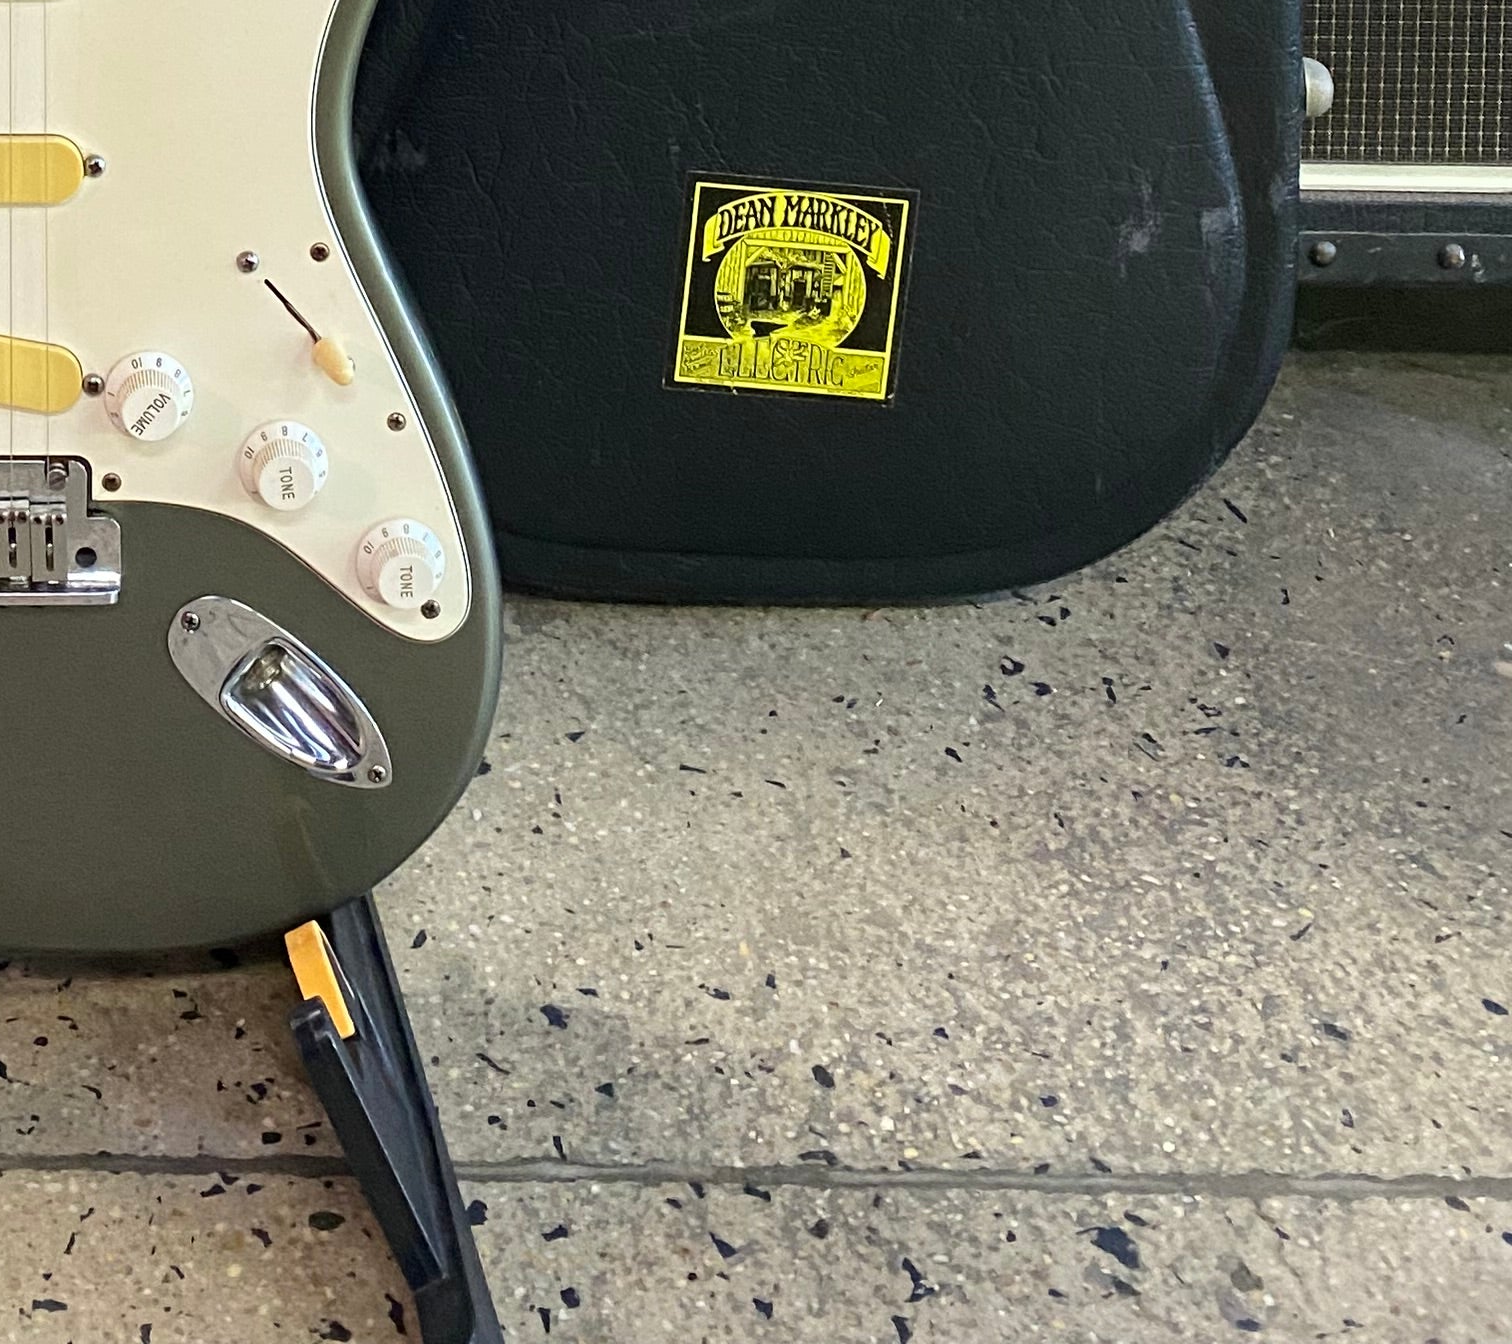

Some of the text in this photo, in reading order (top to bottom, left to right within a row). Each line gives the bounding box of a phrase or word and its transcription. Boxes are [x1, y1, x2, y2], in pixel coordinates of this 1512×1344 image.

[717, 195, 882, 250] DEAN MARKLEY
[131, 393, 171, 436] VOLUME
[279, 466, 295, 500] TONE
[400, 565, 413, 598] TONE
